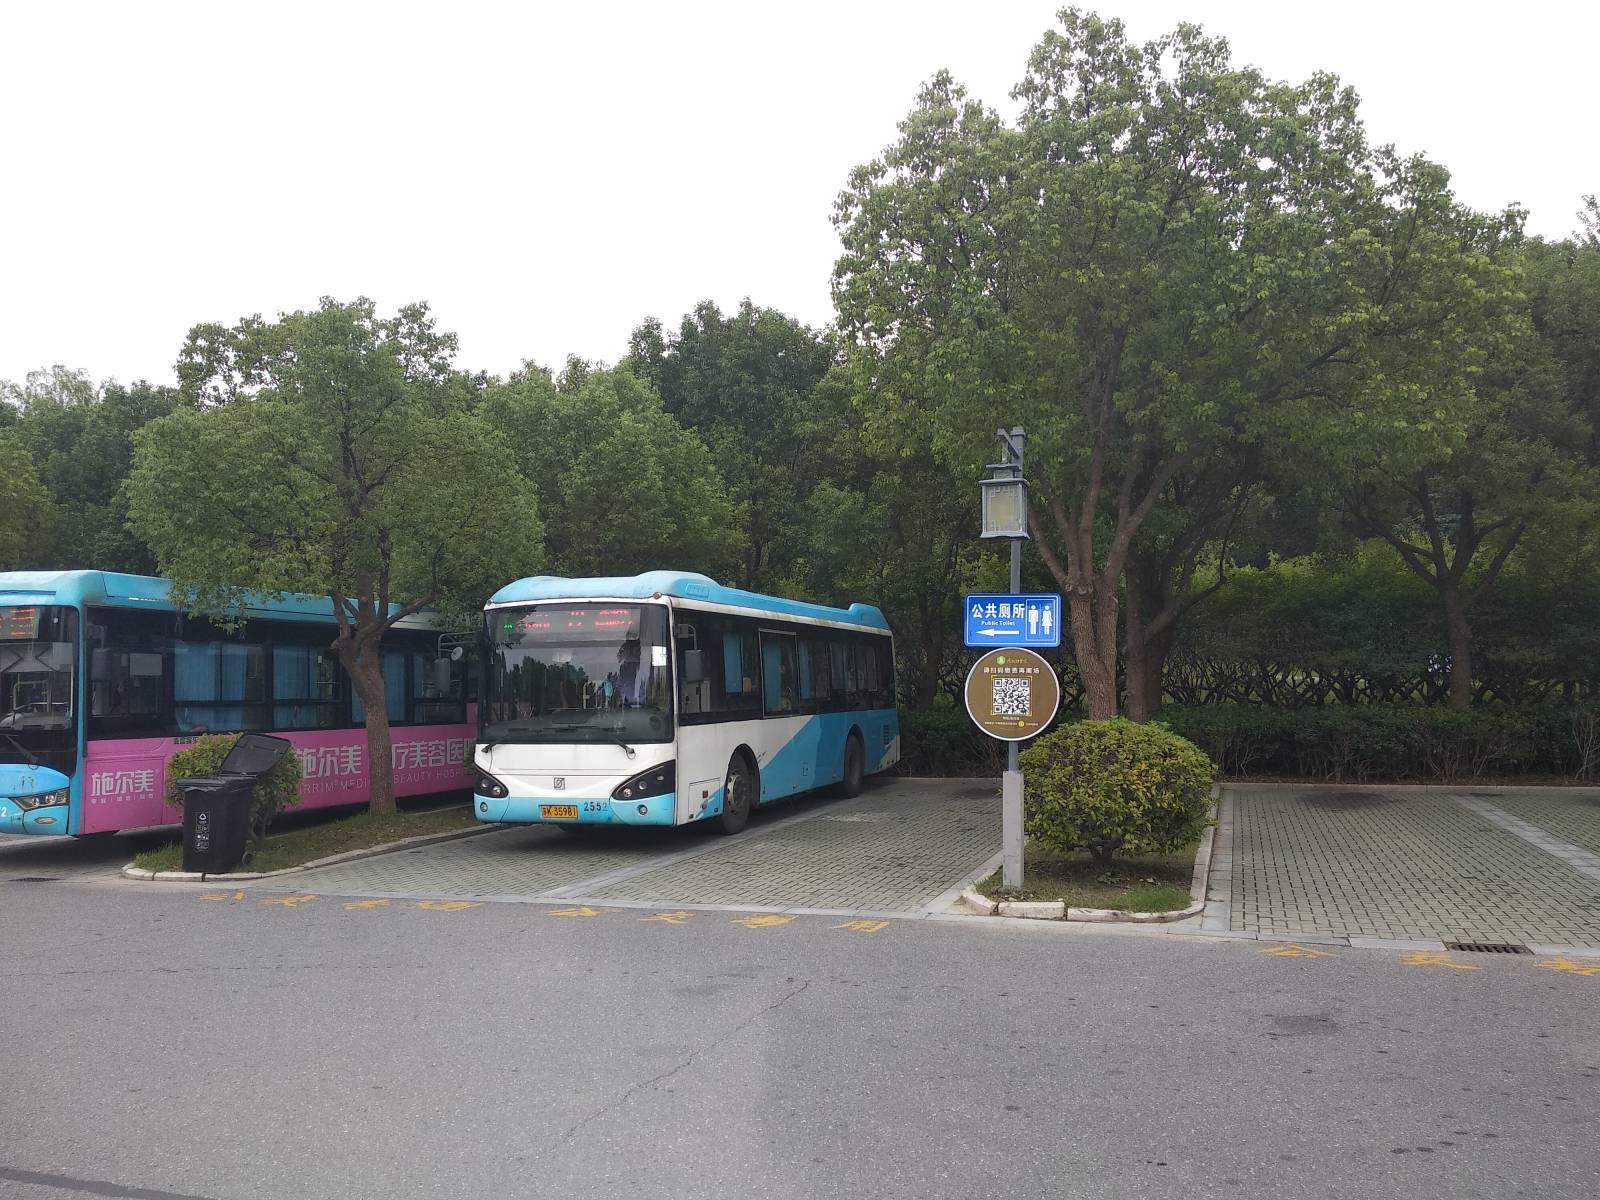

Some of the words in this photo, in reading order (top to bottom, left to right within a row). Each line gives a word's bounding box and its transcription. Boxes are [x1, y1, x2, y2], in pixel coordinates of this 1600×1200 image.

[971, 603, 1025, 618] 公共厕所
[91, 769, 154, 797] 施尔美
[393, 770, 431, 785] BEAUTY
[583, 801, 609, 812] 2552
